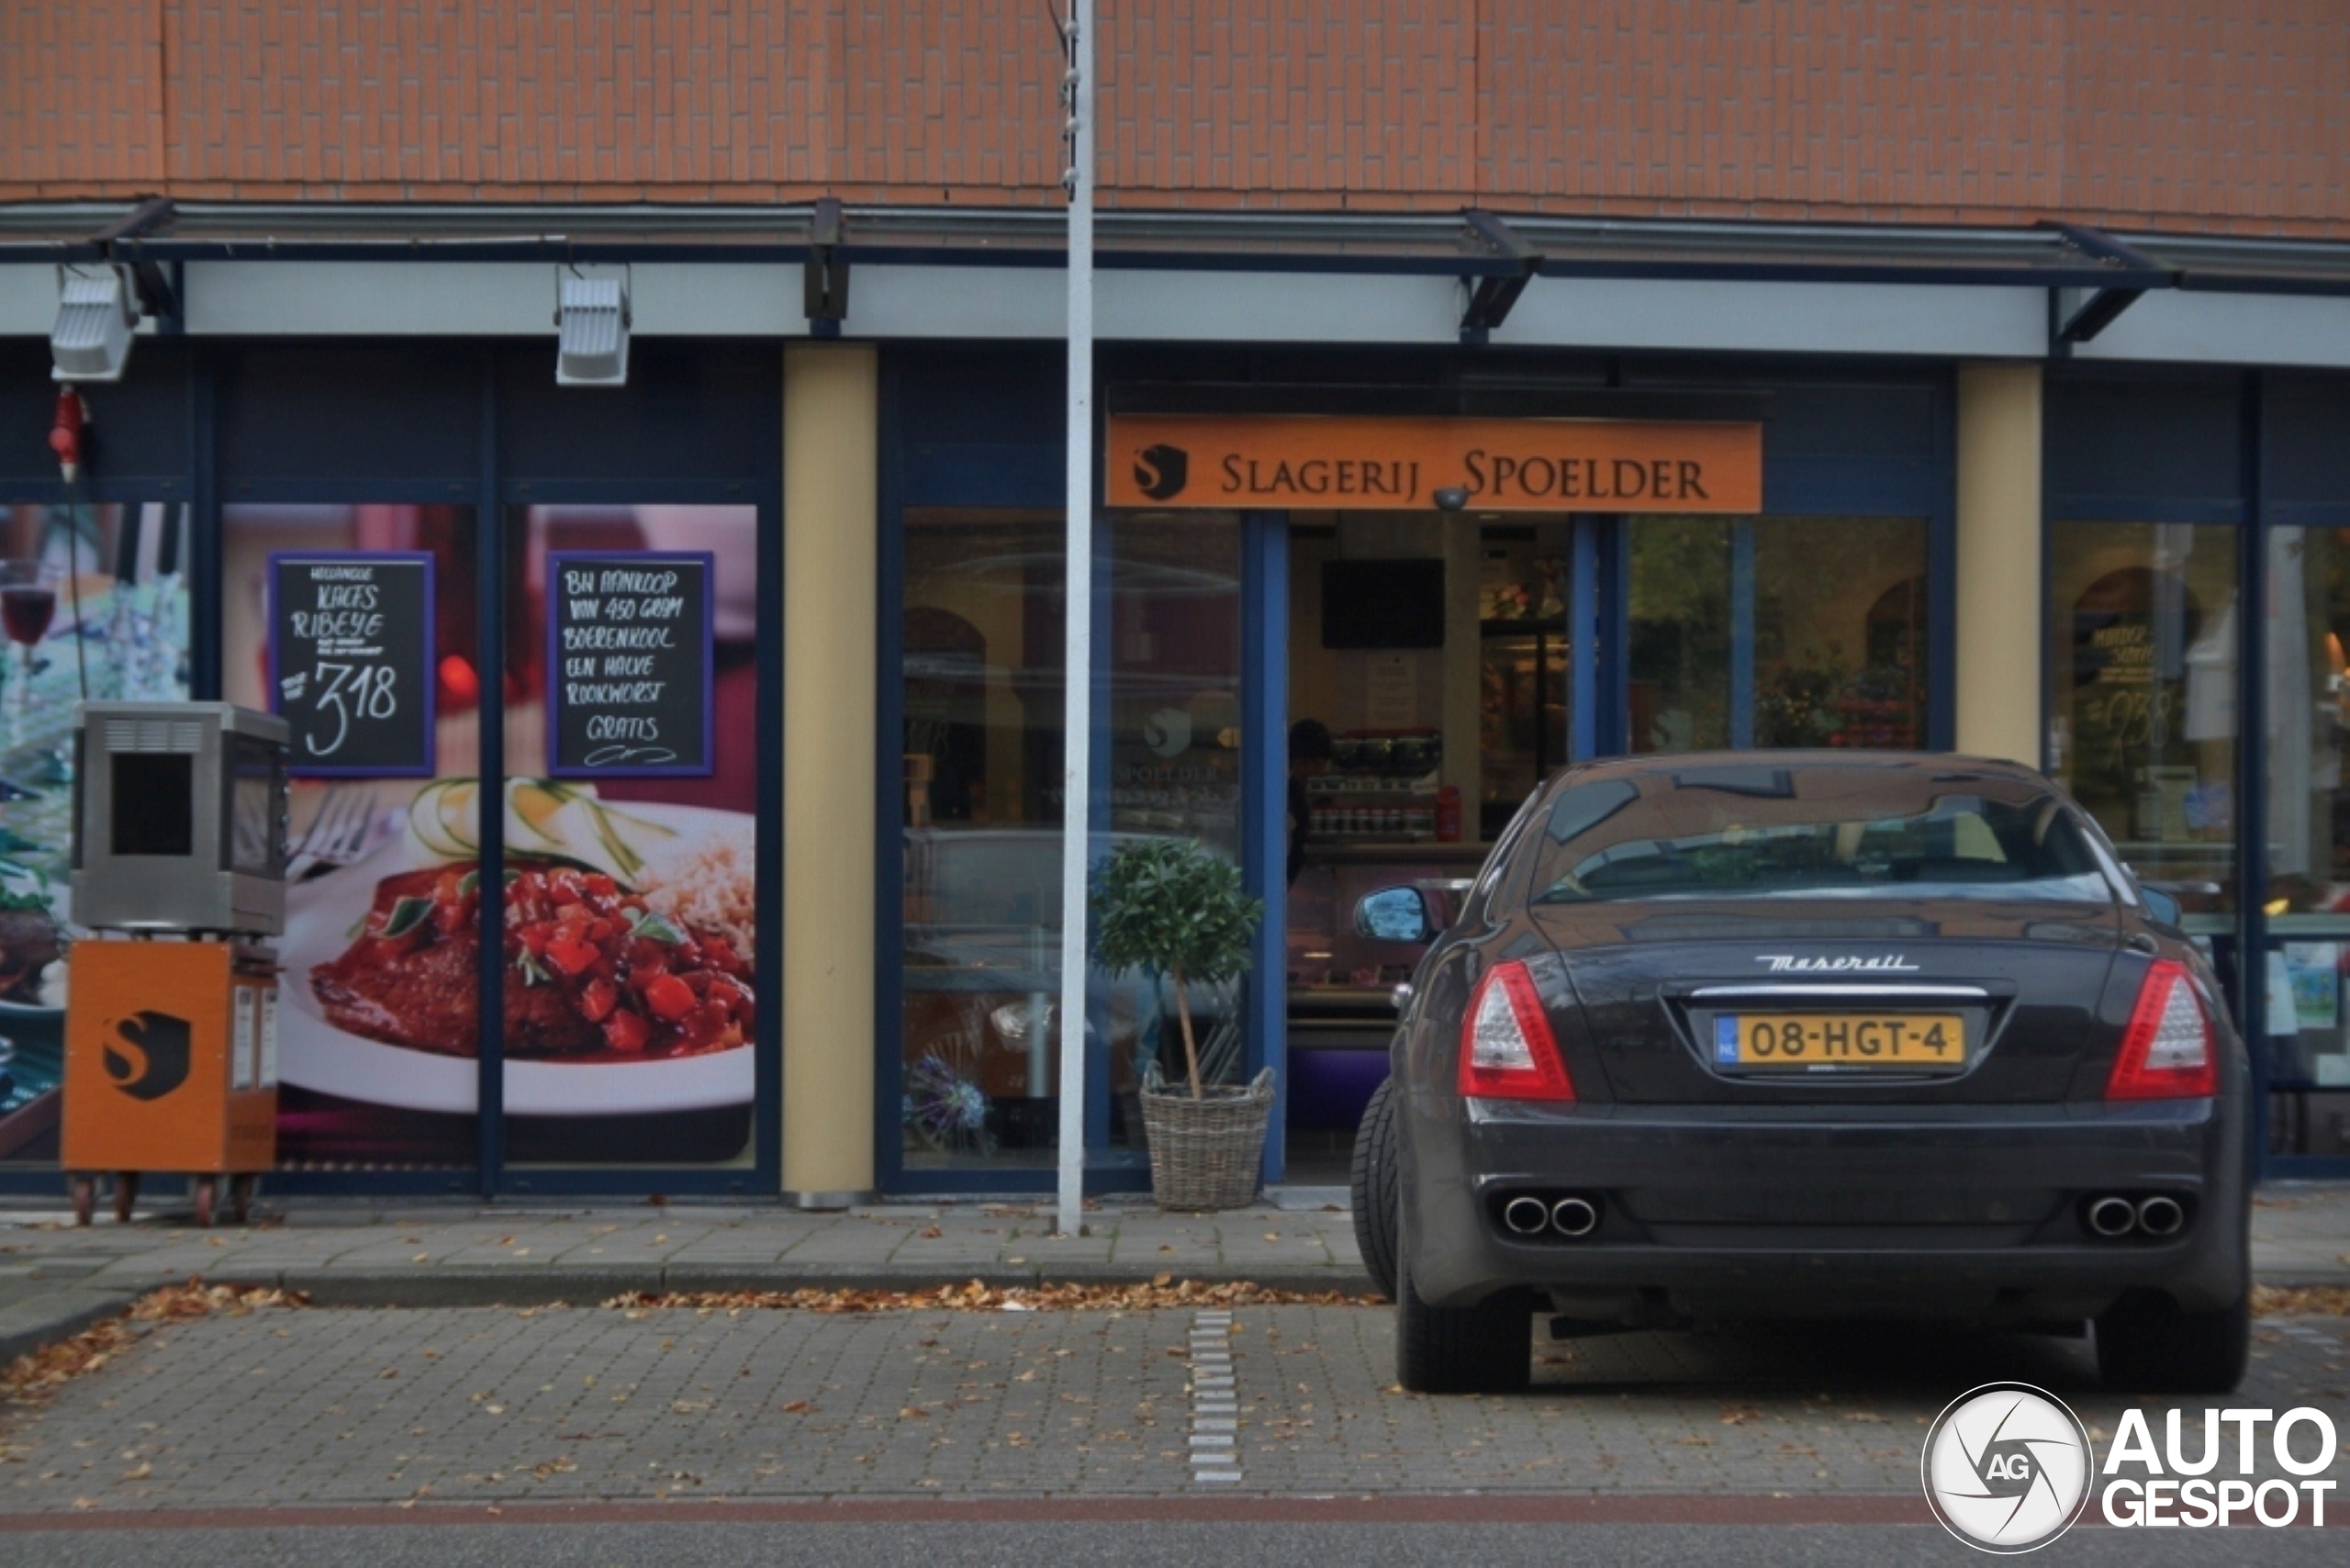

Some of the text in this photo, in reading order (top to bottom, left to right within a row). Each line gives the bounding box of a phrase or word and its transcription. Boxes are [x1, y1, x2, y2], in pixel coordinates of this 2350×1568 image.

[1222, 454, 1419, 502] SLAGERIJ
[1462, 450, 1708, 499] SPOELDER
[605, 598, 635, 621] 450
[640, 597, 684, 618] GRAM
[291, 610, 385, 637] RIBEYE
[563, 626, 677, 650] BOERENKOOL
[565, 655, 655, 677] EEN HALVE
[565, 681, 666, 705] ROOKWORST
[587, 715, 659, 741] GRATIS
[1755, 955, 1919, 970] Maserati
[1718, 1022, 1948, 1057] NL 08-HGT-4
